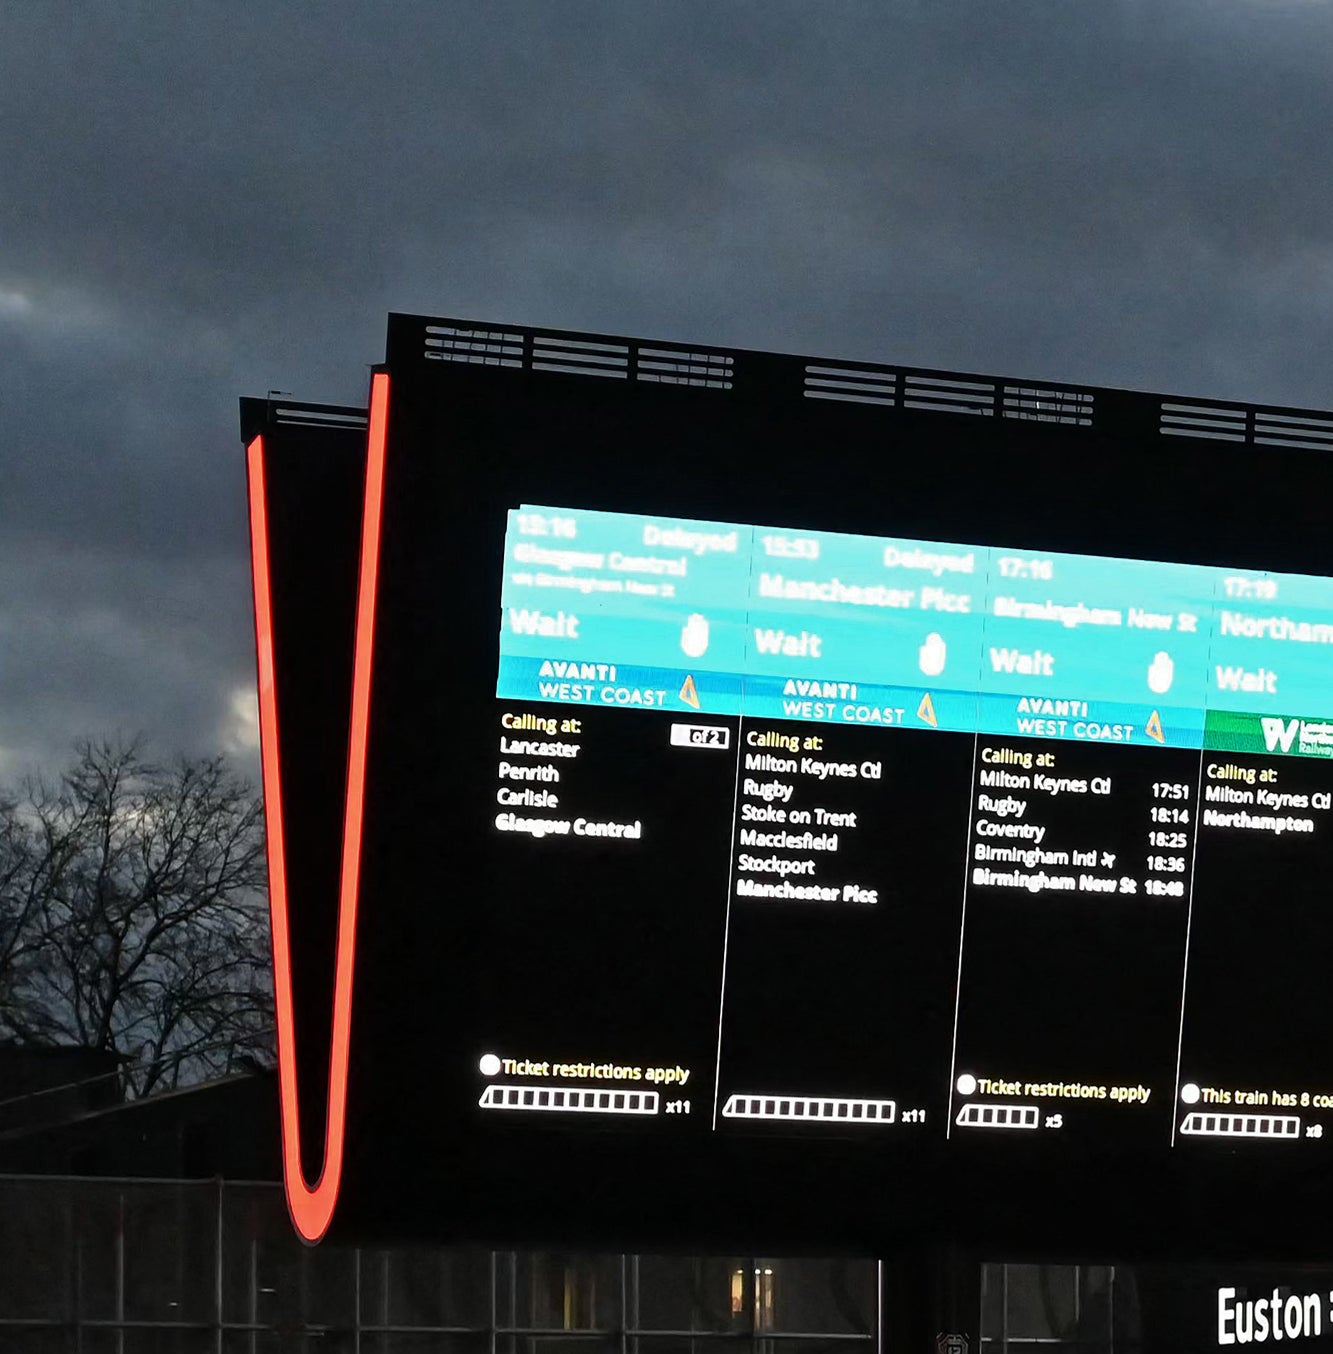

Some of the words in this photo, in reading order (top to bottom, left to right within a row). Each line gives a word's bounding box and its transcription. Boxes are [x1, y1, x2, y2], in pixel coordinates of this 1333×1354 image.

[760, 573, 914, 609] Manchester
[509, 609, 580, 640] Wait
[754, 629, 822, 658] Wait
[539, 661, 616, 682] AVANTI
[989, 649, 1054, 677] Wait
[783, 680, 857, 701] AVANTI
[1216, 665, 1277, 695] Wait
[538, 682, 593, 702] WEST
[600, 686, 666, 706] COAST
[782, 701, 837, 720] WEST
[842, 705, 905, 724] COAST
[1017, 698, 1087, 717] AVANTI
[502, 713, 557, 735] Calling
[561, 716, 582, 734] at:
[1017, 718, 1068, 736] WEST
[1074, 722, 1134, 741] COAST
[500, 737, 580, 760] Lancaster
[747, 731, 800, 752] Calling
[803, 735, 823, 752] at:
[745, 754, 797, 774] Milton
[800, 757, 858, 780] Keynes
[982, 748, 1033, 769] Calling
[1036, 751, 1055, 768] at:
[500, 763, 560, 782] Penrith
[1207, 763, 1256, 784] Calling
[1259, 766, 1278, 783] at:
[743, 780, 793, 802] Rugby
[980, 770, 1030, 790] Milton
[1033, 775, 1087, 796] Keynes
[1152, 783, 1189, 799] 17:51
[497, 788, 558, 808] Carlisle
[1205, 786, 1254, 805] Milton
[1257, 789, 1309, 810] Keynes
[742, 805, 786, 824] Stoke
[790, 810, 811, 826] on
[815, 808, 856, 828] Trent
[978, 796, 1027, 817] Rugby
[1150, 808, 1189, 825] 18:14
[1204, 809, 1314, 835] Northampton
[740, 830, 838, 852] Macclesfield
[976, 820, 1046, 844] Coventry
[1148, 832, 1187, 849] 18:25
[739, 854, 815, 877] Stockport
[974, 844, 1069, 868] Birmingham
[1147, 855, 1186, 872] 18:36
[503, 1058, 550, 1077] Ticket
[553, 1062, 641, 1081] restrictions
[645, 1065, 690, 1085] apply
[978, 1078, 1021, 1096] Ticket
[1025, 1081, 1107, 1100] restrictions
[1110, 1084, 1151, 1103] apply
[1202, 1087, 1232, 1105] This
[1236, 1090, 1269, 1105] train
[1272, 1090, 1297, 1106] has
[1300, 1092, 1309, 1106] 8
[665, 1100, 690, 1115] x11
[1218, 1287, 1321, 1345] Euston
